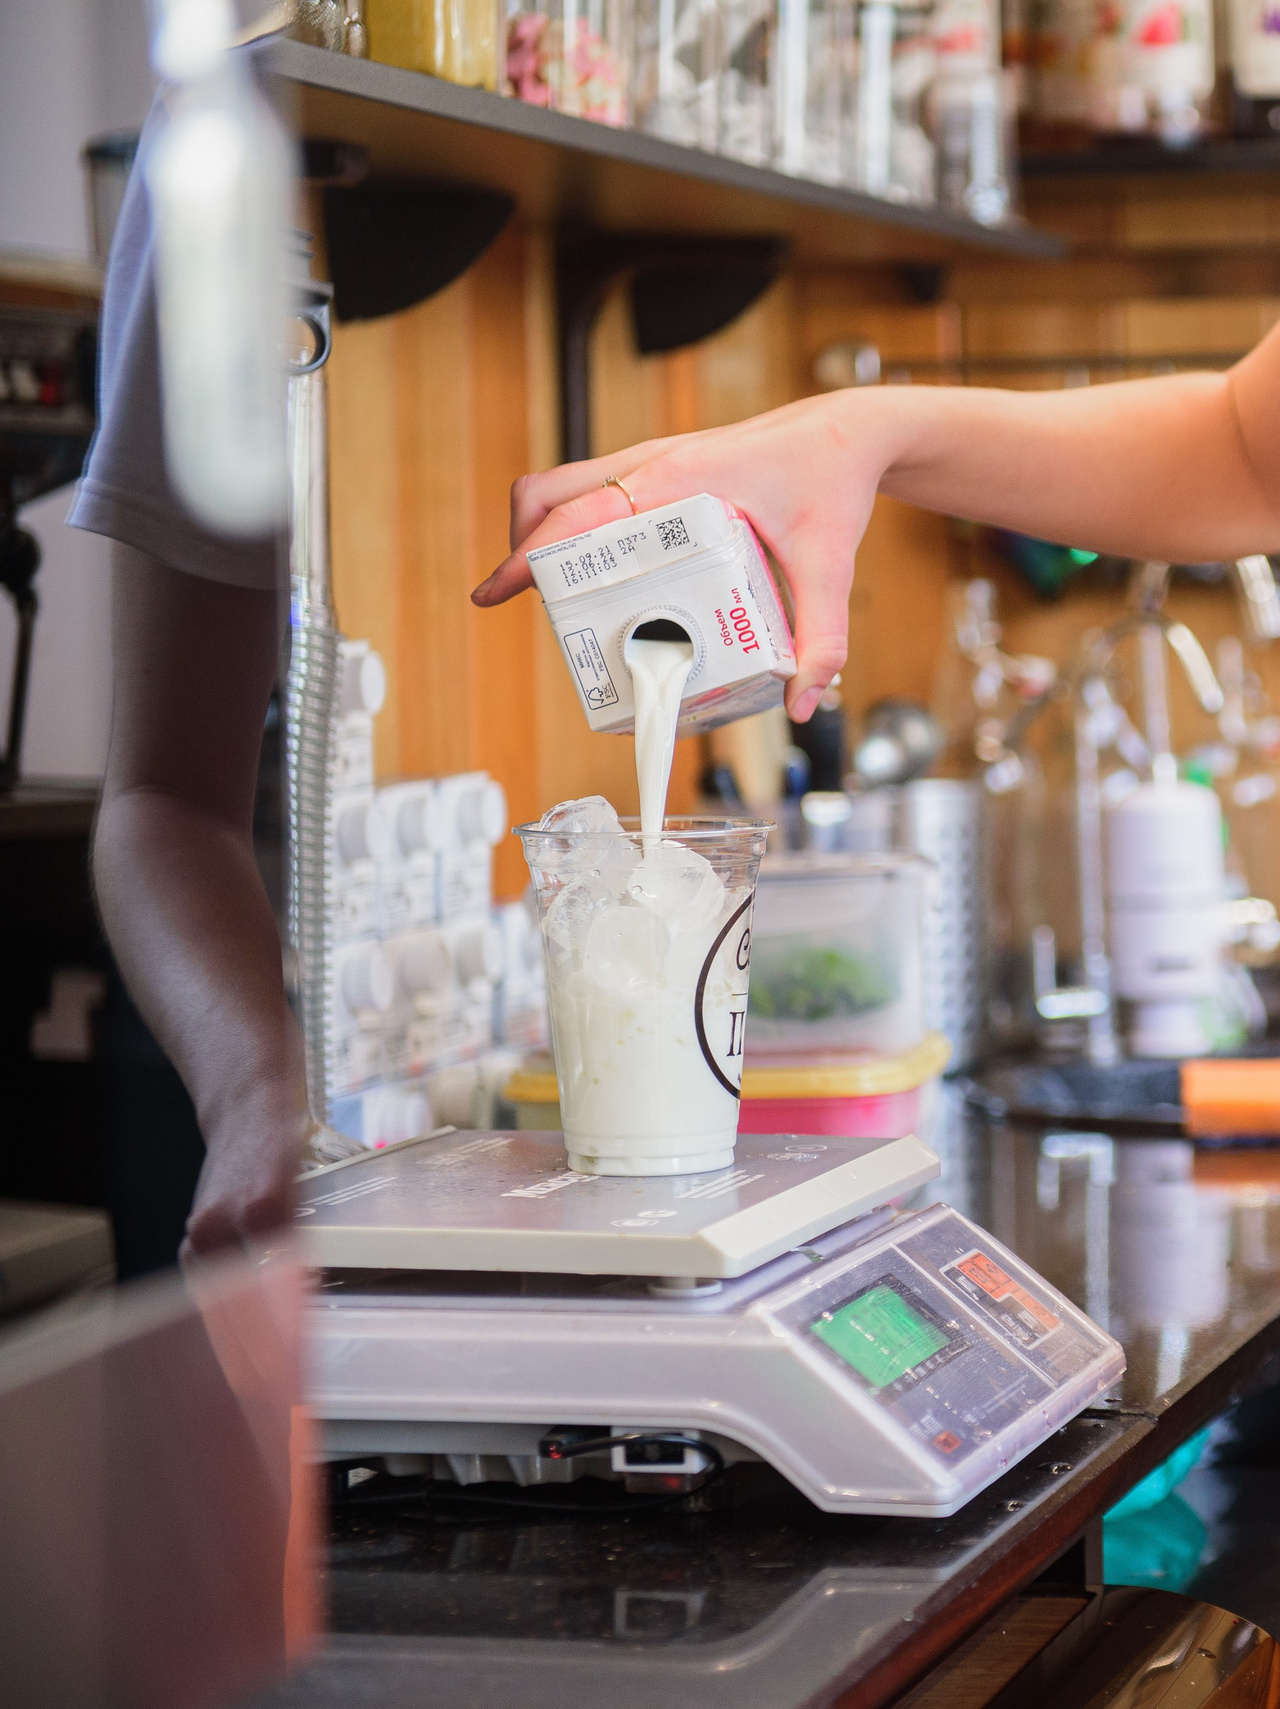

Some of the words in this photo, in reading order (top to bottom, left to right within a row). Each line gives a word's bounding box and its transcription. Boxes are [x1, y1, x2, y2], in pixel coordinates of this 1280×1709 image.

[560, 545, 611, 572] 15.09.21
[617, 532, 647, 549] П373
[562, 552, 614, 579] 12.06.22
[565, 560, 618, 587] 16:11:03
[731, 587, 743, 604] мл
[714, 608, 734, 647] Объем
[729, 606, 760, 655] 1000
